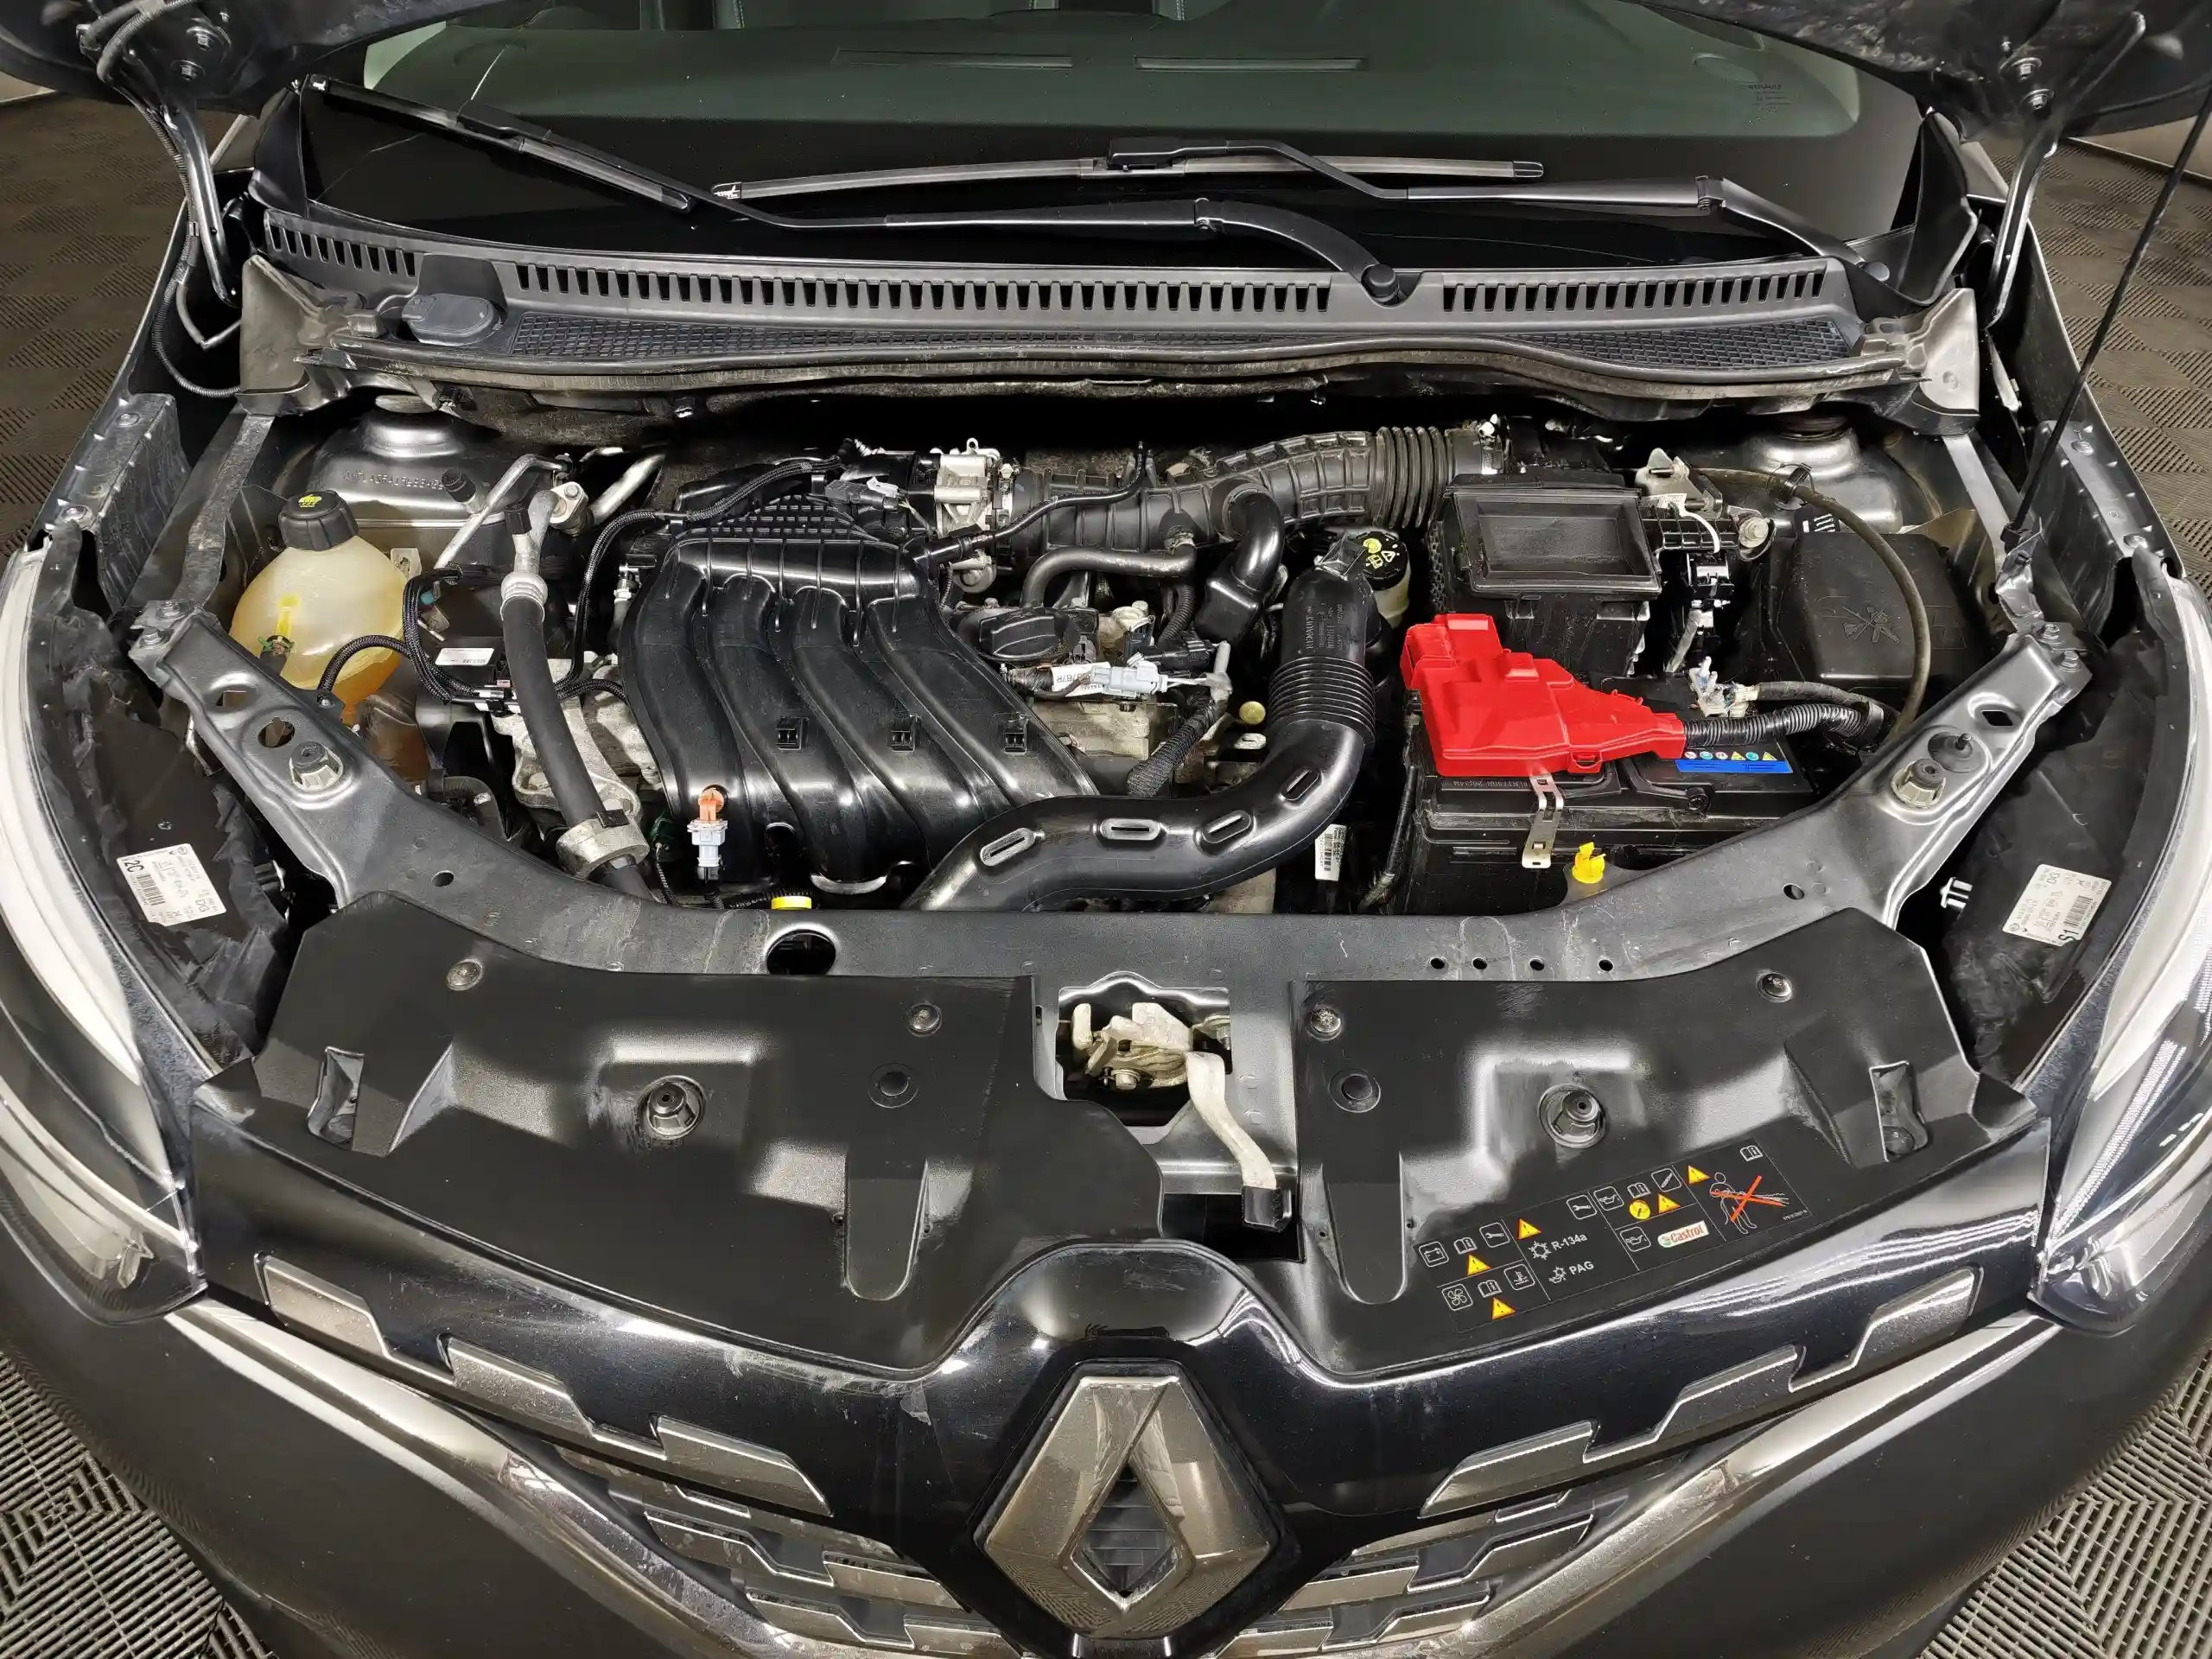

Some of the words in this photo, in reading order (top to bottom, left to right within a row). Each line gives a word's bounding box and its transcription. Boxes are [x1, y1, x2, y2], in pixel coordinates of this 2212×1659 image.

[124, 860, 144, 873] 2C
[1670, 1224, 1705, 1243] Castrol
[1551, 1234, 1587, 1251] R-134a
[1569, 1261, 1595, 1275] PAG
